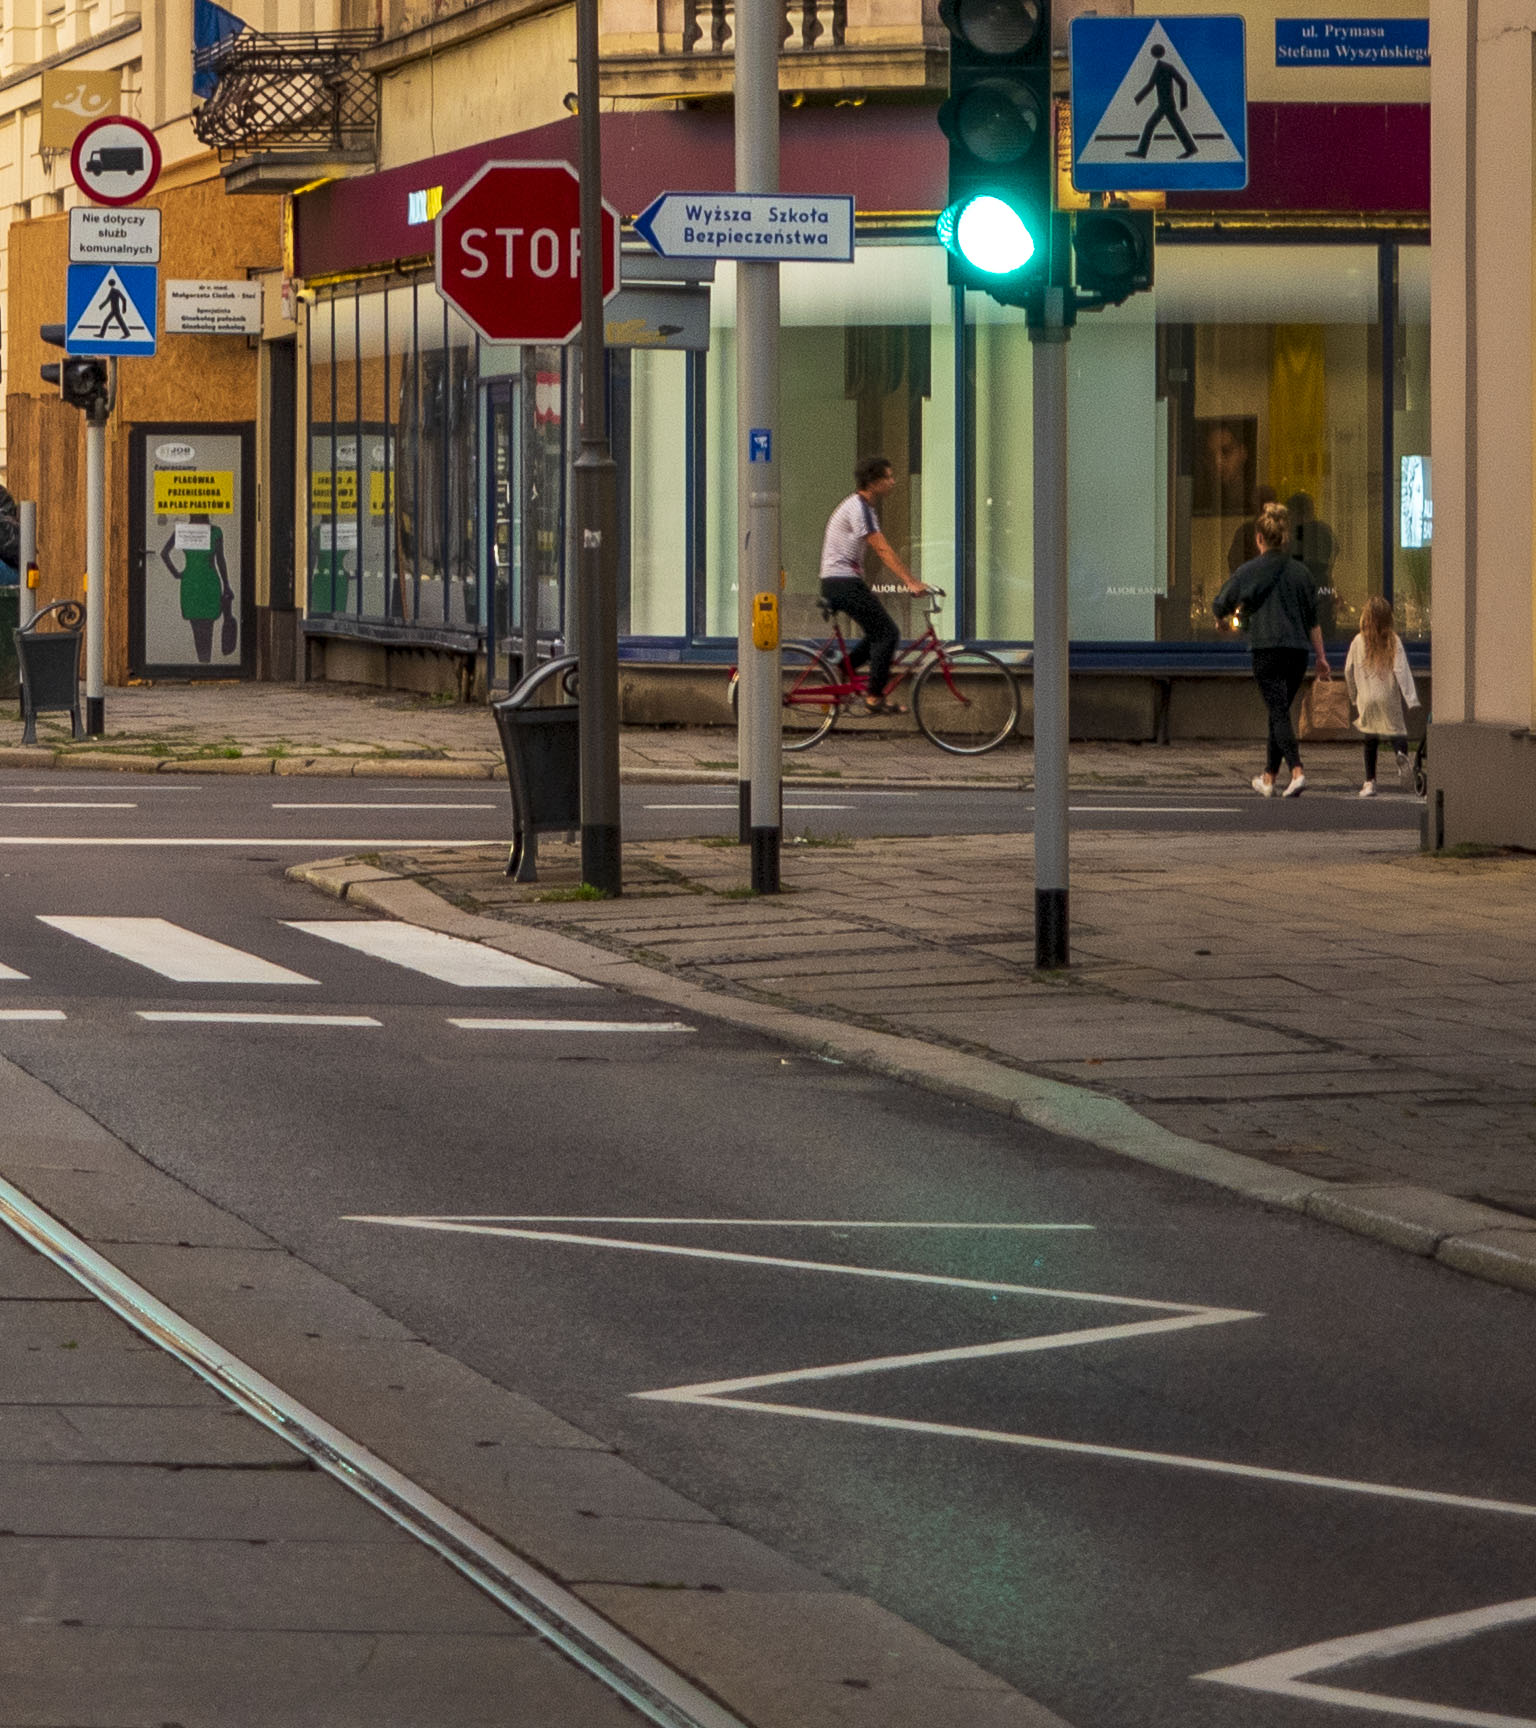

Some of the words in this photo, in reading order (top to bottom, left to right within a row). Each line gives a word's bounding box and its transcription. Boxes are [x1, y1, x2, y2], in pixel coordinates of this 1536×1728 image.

[1302, 25, 1318, 38] ul.
[1324, 23, 1385, 41] Prymasa
[1278, 45, 1330, 59] Stefana
[82, 214, 100, 223] Nie
[103, 213, 145, 226] dotyczy
[685, 204, 752, 227] Wyższa
[768, 206, 829, 224] Szkoła
[98, 229, 128, 238] służb
[684, 227, 829, 248] Bezpieczeństwa
[79, 243, 153, 256] komunalnych
